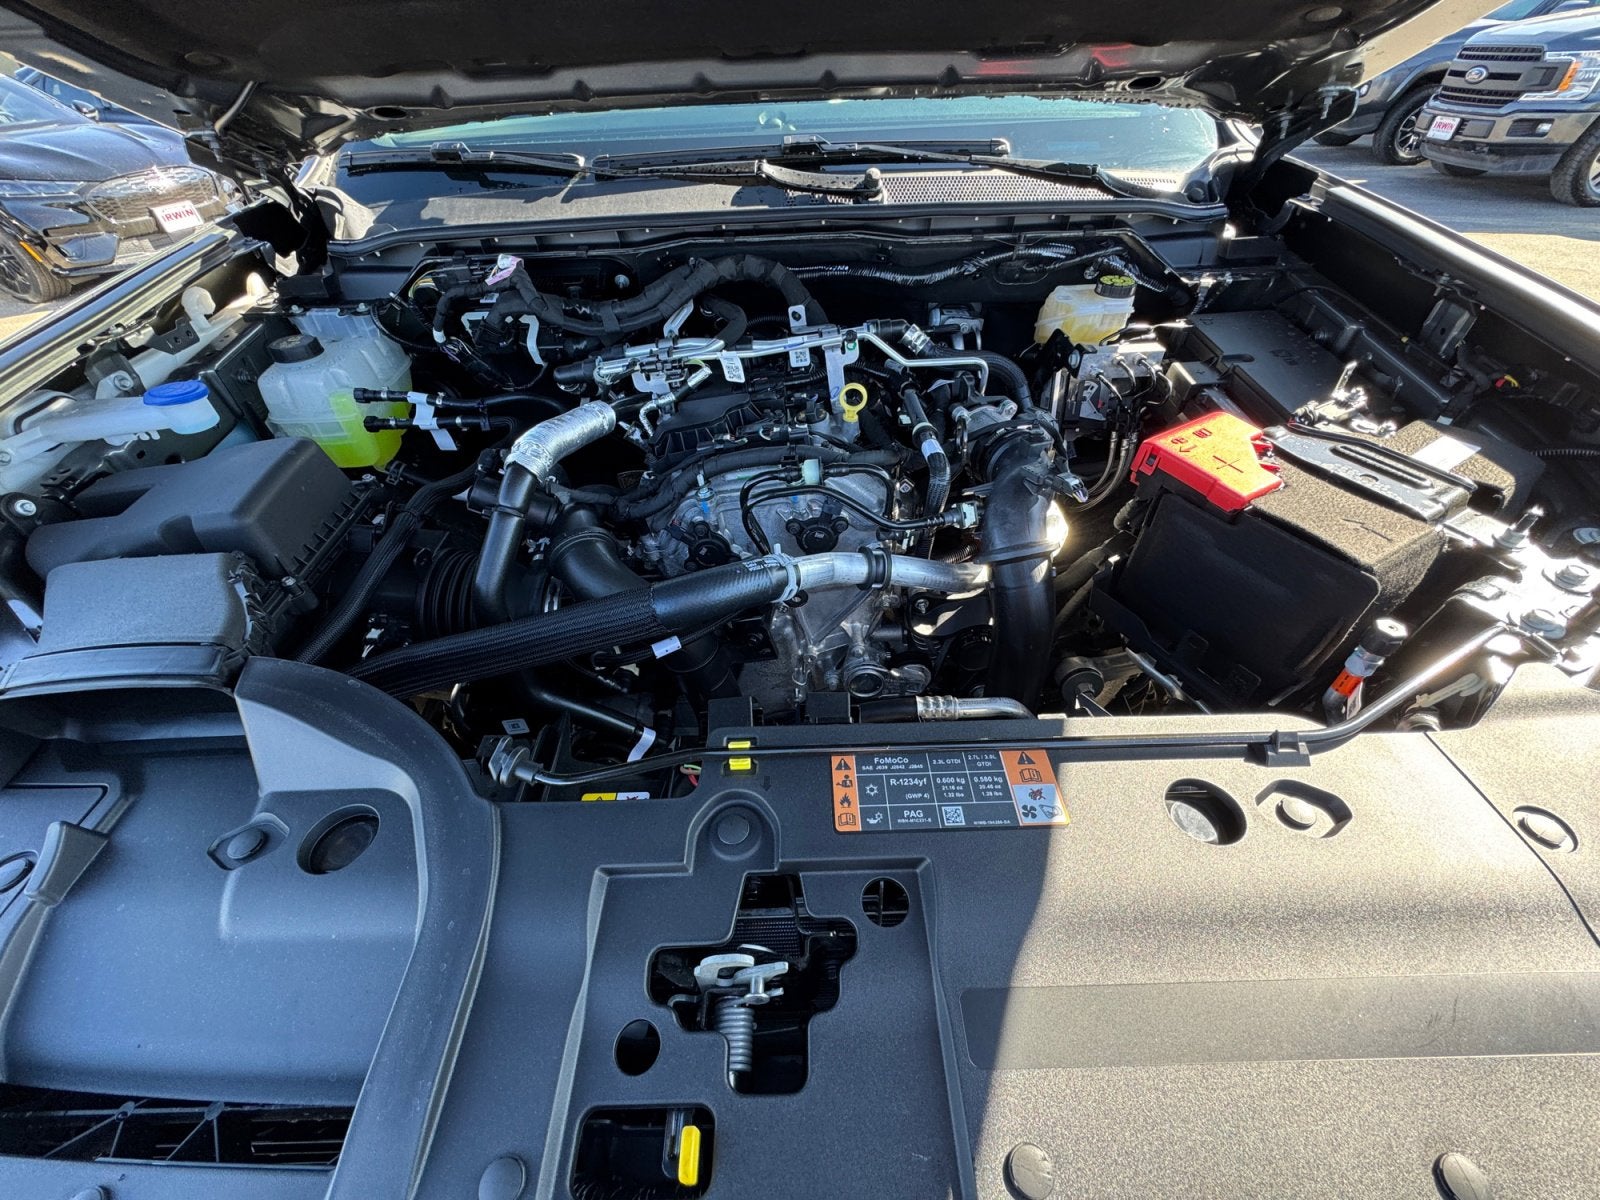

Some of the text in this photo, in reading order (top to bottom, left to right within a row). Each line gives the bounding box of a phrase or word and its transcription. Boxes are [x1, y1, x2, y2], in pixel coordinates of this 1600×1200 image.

[1433, 121, 1454, 131] IRWIN
[161, 208, 194, 222] IRWIN
[890, 777, 927, 786] R-1234yf
[903, 810, 924, 818] PAG
